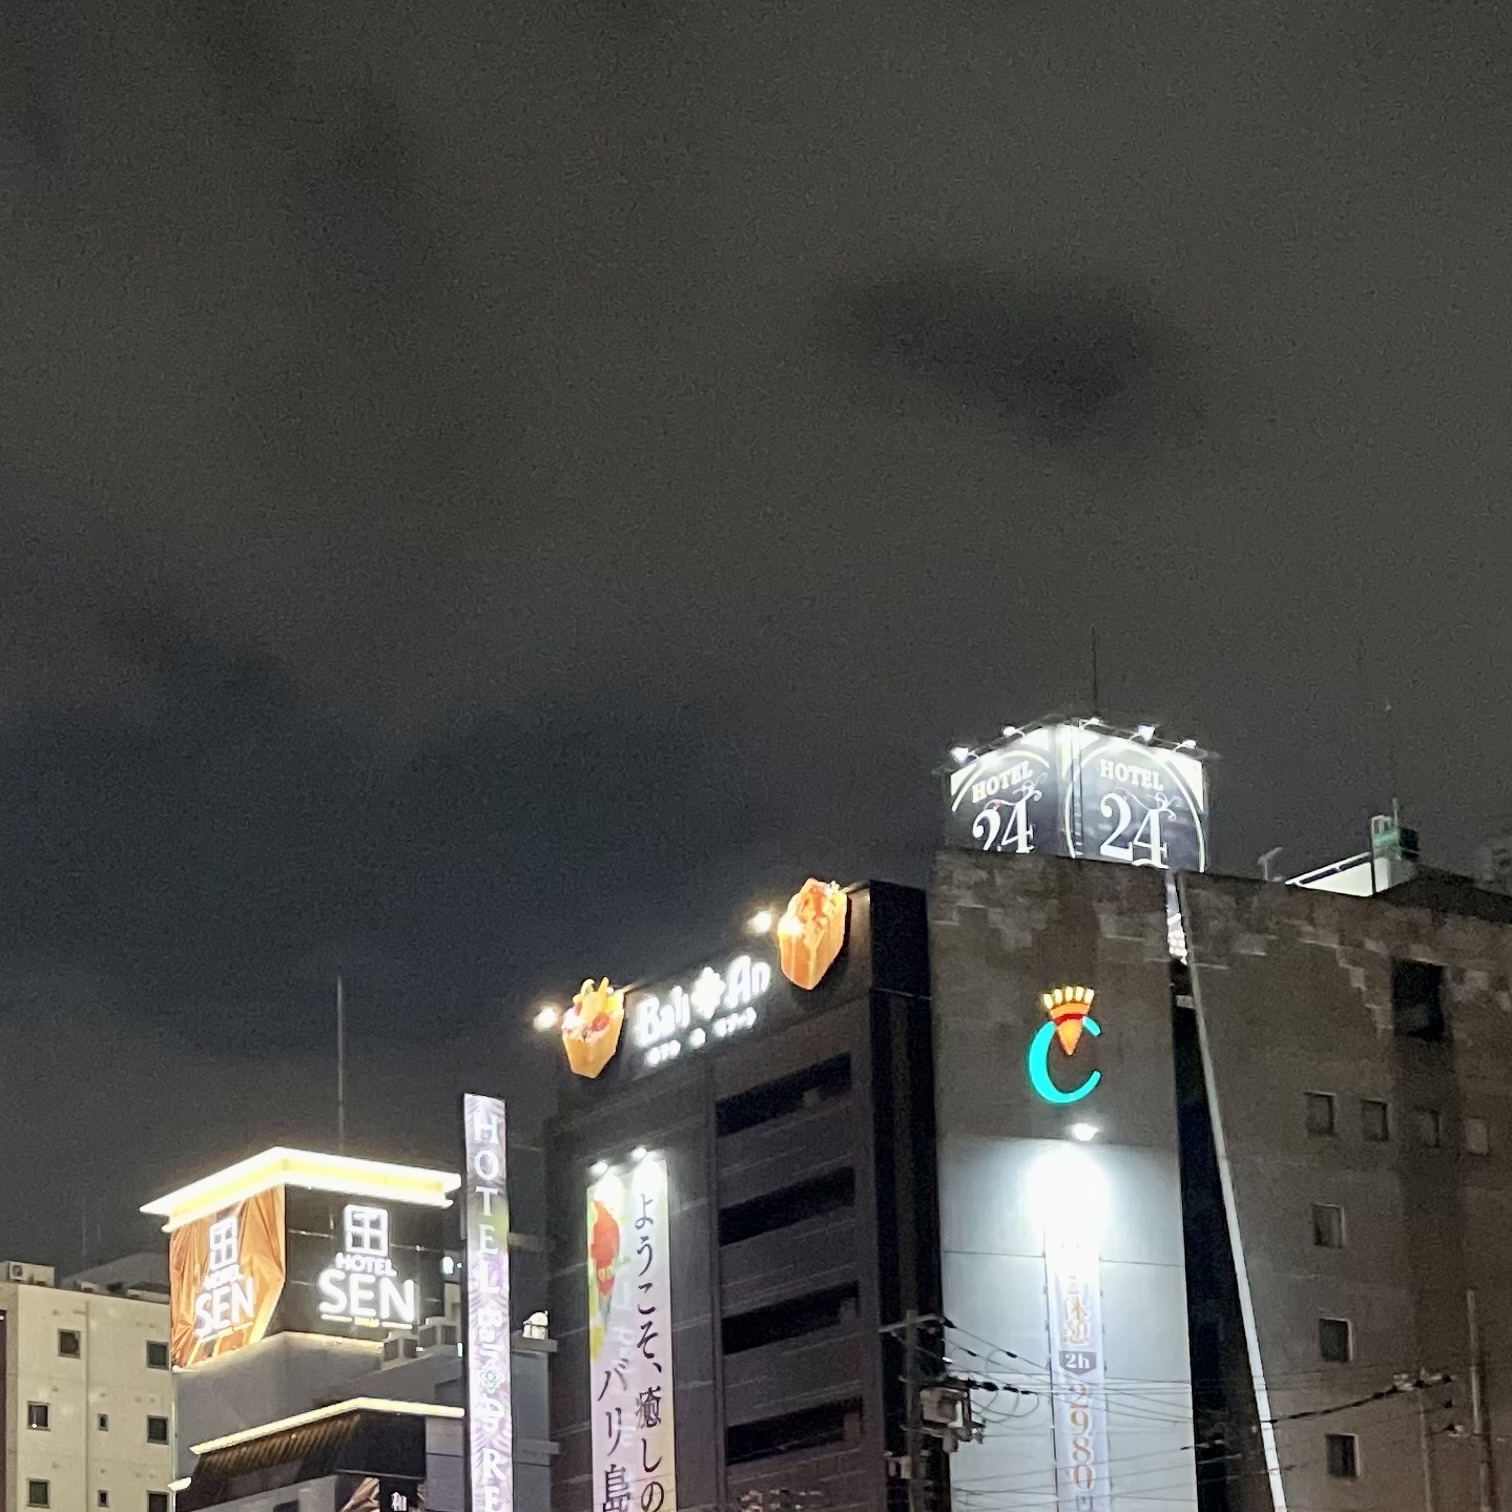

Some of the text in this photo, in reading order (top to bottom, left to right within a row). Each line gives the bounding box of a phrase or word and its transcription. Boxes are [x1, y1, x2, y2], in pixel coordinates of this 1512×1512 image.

[972, 761, 1033, 803] HOTEL
[1099, 759, 1164, 791] HOTEL
[1099, 792, 1175, 870] 24
[725, 954, 771, 1009] An
[473, 1107, 501, 1293] HOTEL
[335, 1251, 397, 1277] HOTEL
[194, 1275, 256, 1339] SEN
[318, 1266, 416, 1323] SEN
[1065, 1353, 1090, 1369] 2h
